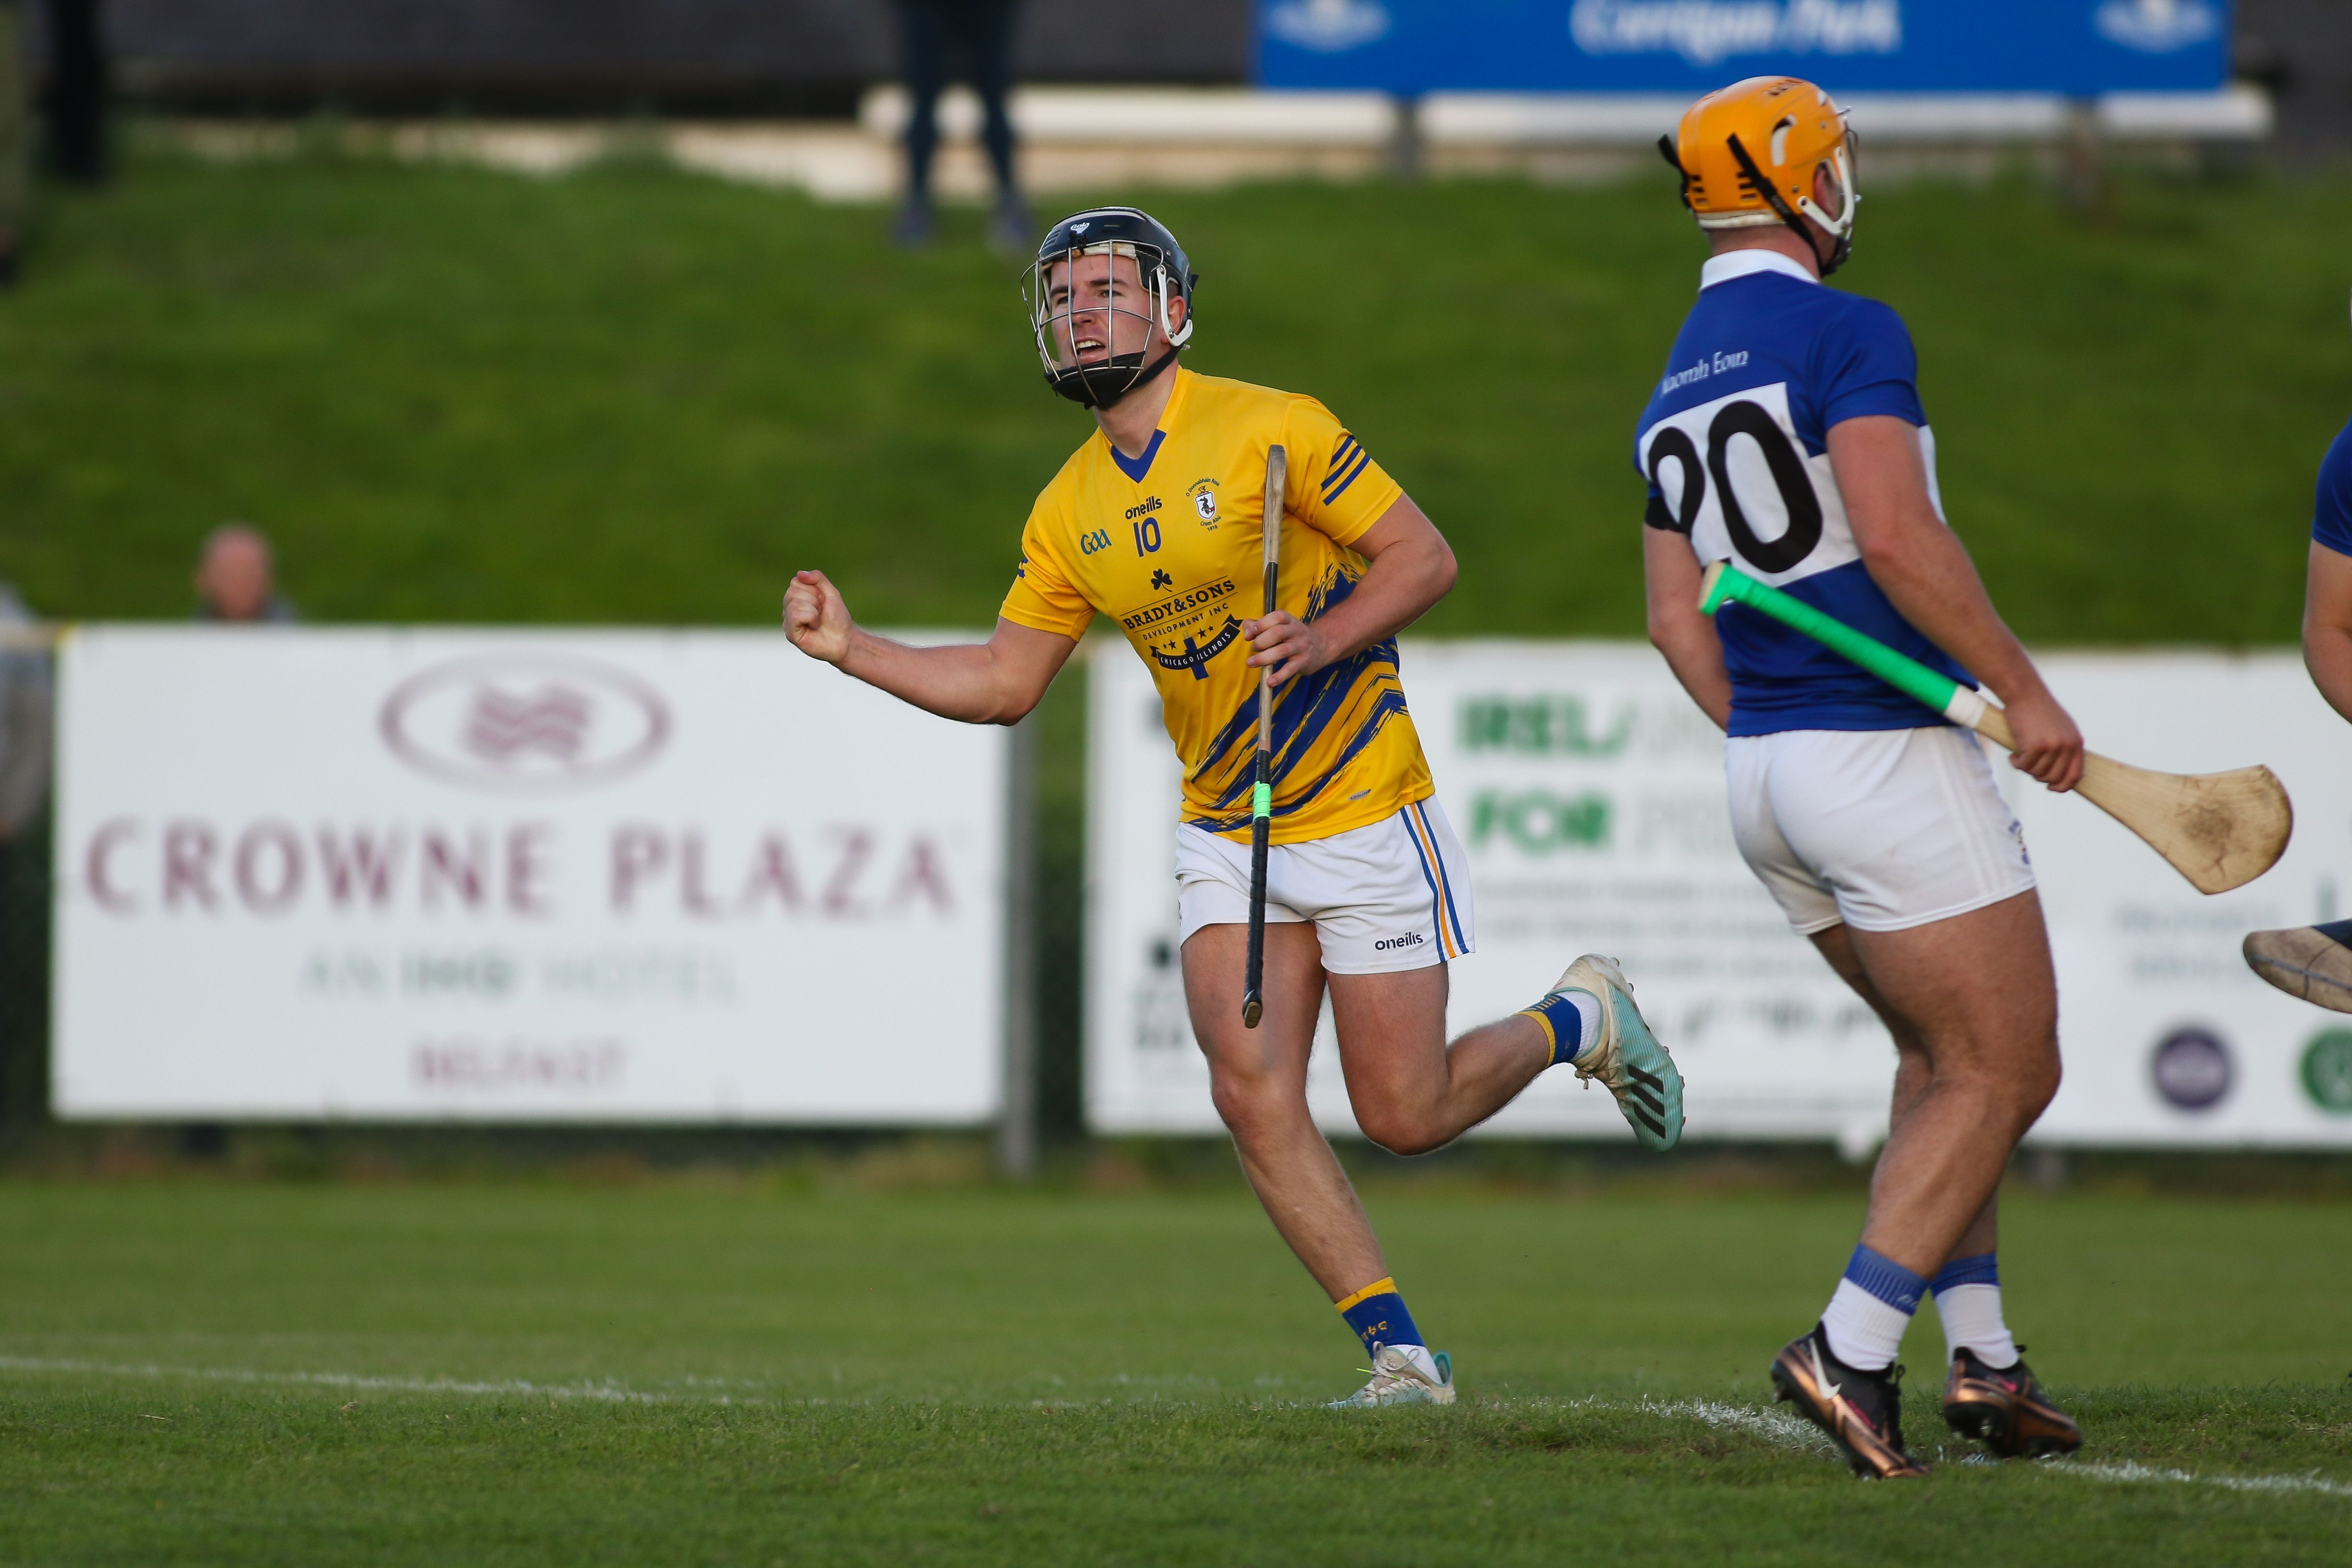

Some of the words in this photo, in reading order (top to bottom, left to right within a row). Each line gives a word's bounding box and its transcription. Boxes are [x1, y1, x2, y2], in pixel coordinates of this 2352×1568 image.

[1133, 517, 1162, 557] 10
[1122, 580, 1236, 630] BRADY&SONS
[1142, 613, 1205, 641] DEVELOPMENT
[1209, 603, 1229, 616] INC
[1160, 655, 1194, 666] CHICAGO
[1197, 632, 1231, 661] ILLINOIS
[1470, 788, 1614, 856] FOR
[87, 818, 553, 918] CROWNE
[609, 820, 957, 921] PLAZA
